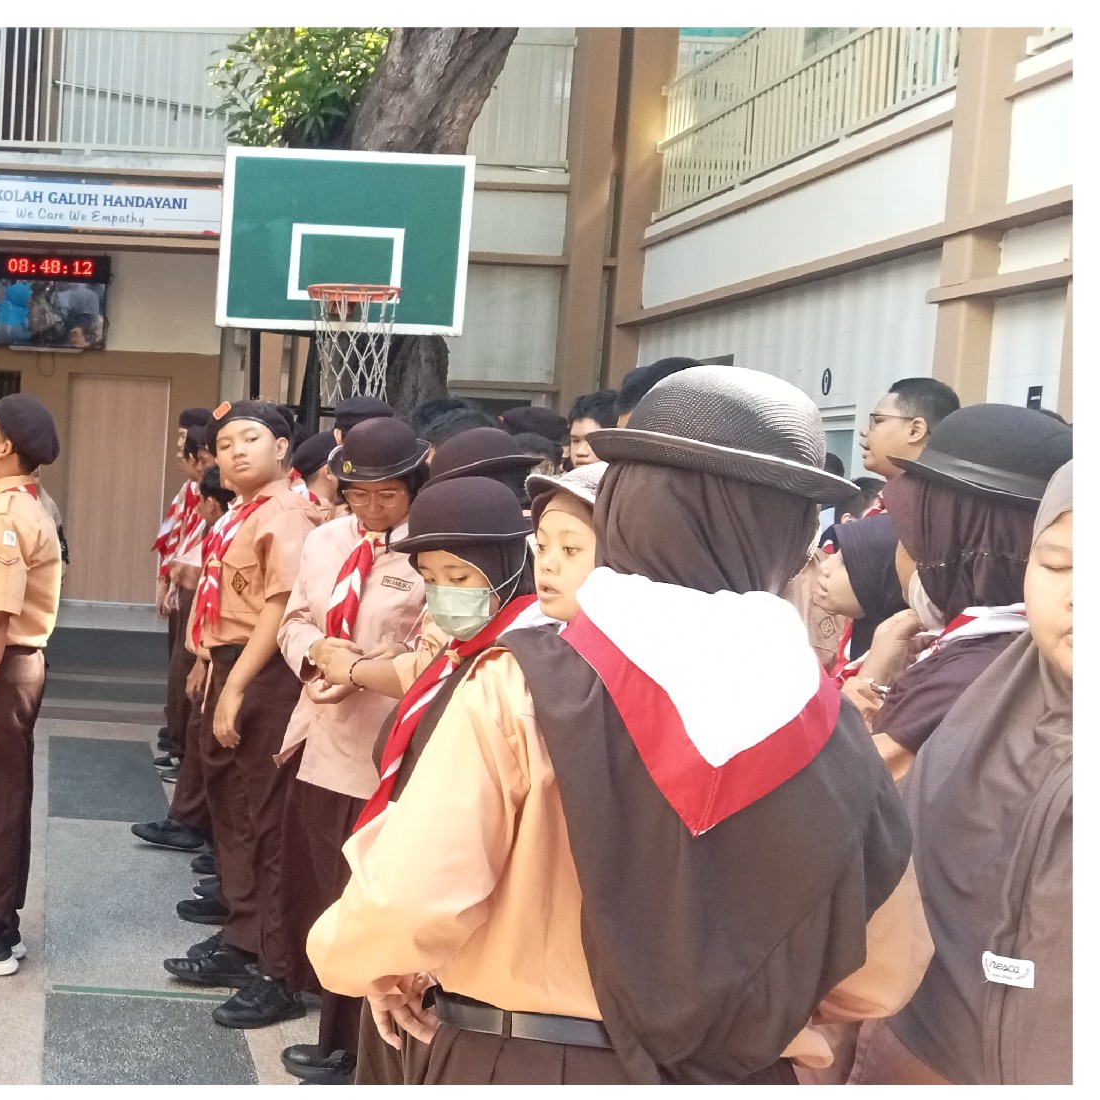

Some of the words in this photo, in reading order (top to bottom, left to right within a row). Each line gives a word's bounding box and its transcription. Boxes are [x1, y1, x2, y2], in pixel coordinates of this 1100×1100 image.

[48, 191, 99, 206] GALUH
[103, 194, 188, 209] HANDAYANI
[16, 207, 34, 219] We
[38, 208, 65, 220] Care
[69, 210, 87, 222] We
[91, 211, 145, 227] Empathy
[8, 258, 92, 275] 08:48:12
